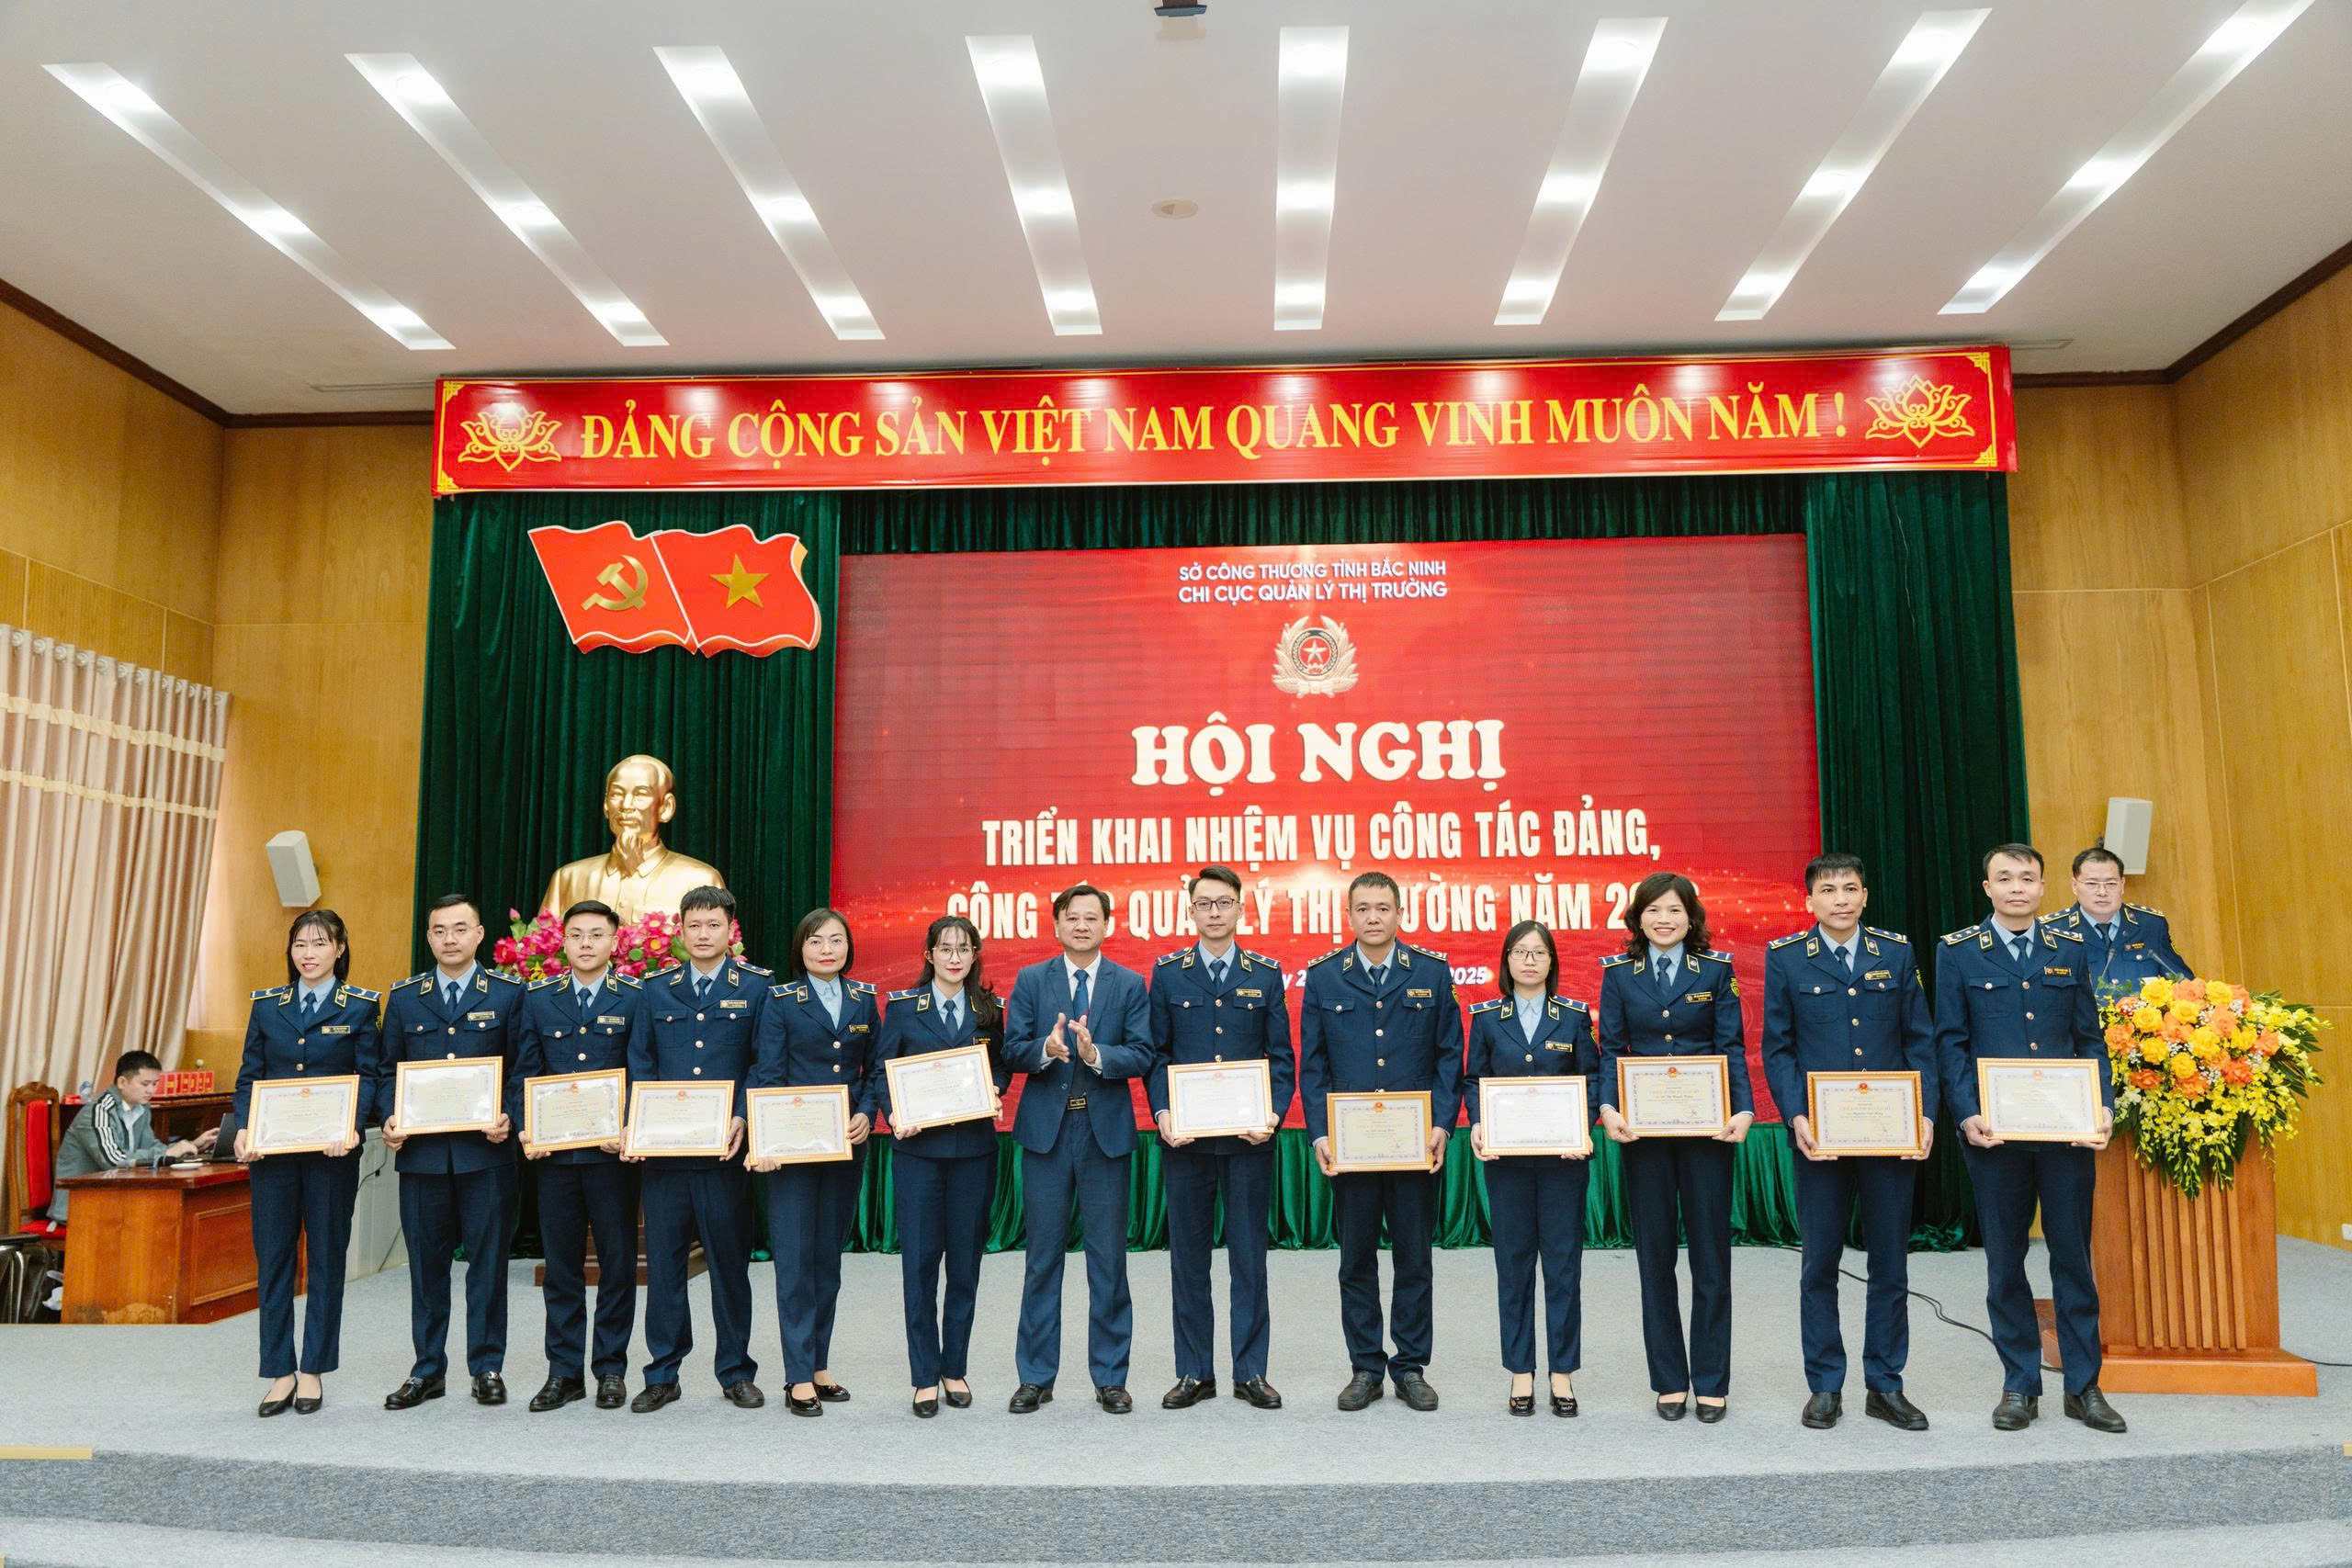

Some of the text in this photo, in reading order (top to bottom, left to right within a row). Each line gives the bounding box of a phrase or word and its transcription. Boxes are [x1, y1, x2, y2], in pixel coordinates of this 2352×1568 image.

[580, 382, 1847, 470] ĐẢNG CỘNG SẢN VIỆT NAM QUANG VINH MUÔN NĂM !
[1178, 578, 1448, 606] CHI CỤC QUẢN LÝ THỊ TRƯỜNG
[1179, 557, 1446, 581] SỞ CÔNG THƯƠNG TỈNH BẮC NINH
[1131, 711, 1507, 796] HỘI NGHỊ
[982, 795, 1662, 872] TRIỂN KHAI NHIỆM VỤ CÔNG TÁC ĐẢNG,
[1287, 887, 1342, 943] THỊ
[1510, 873, 1591, 931] NĂM
